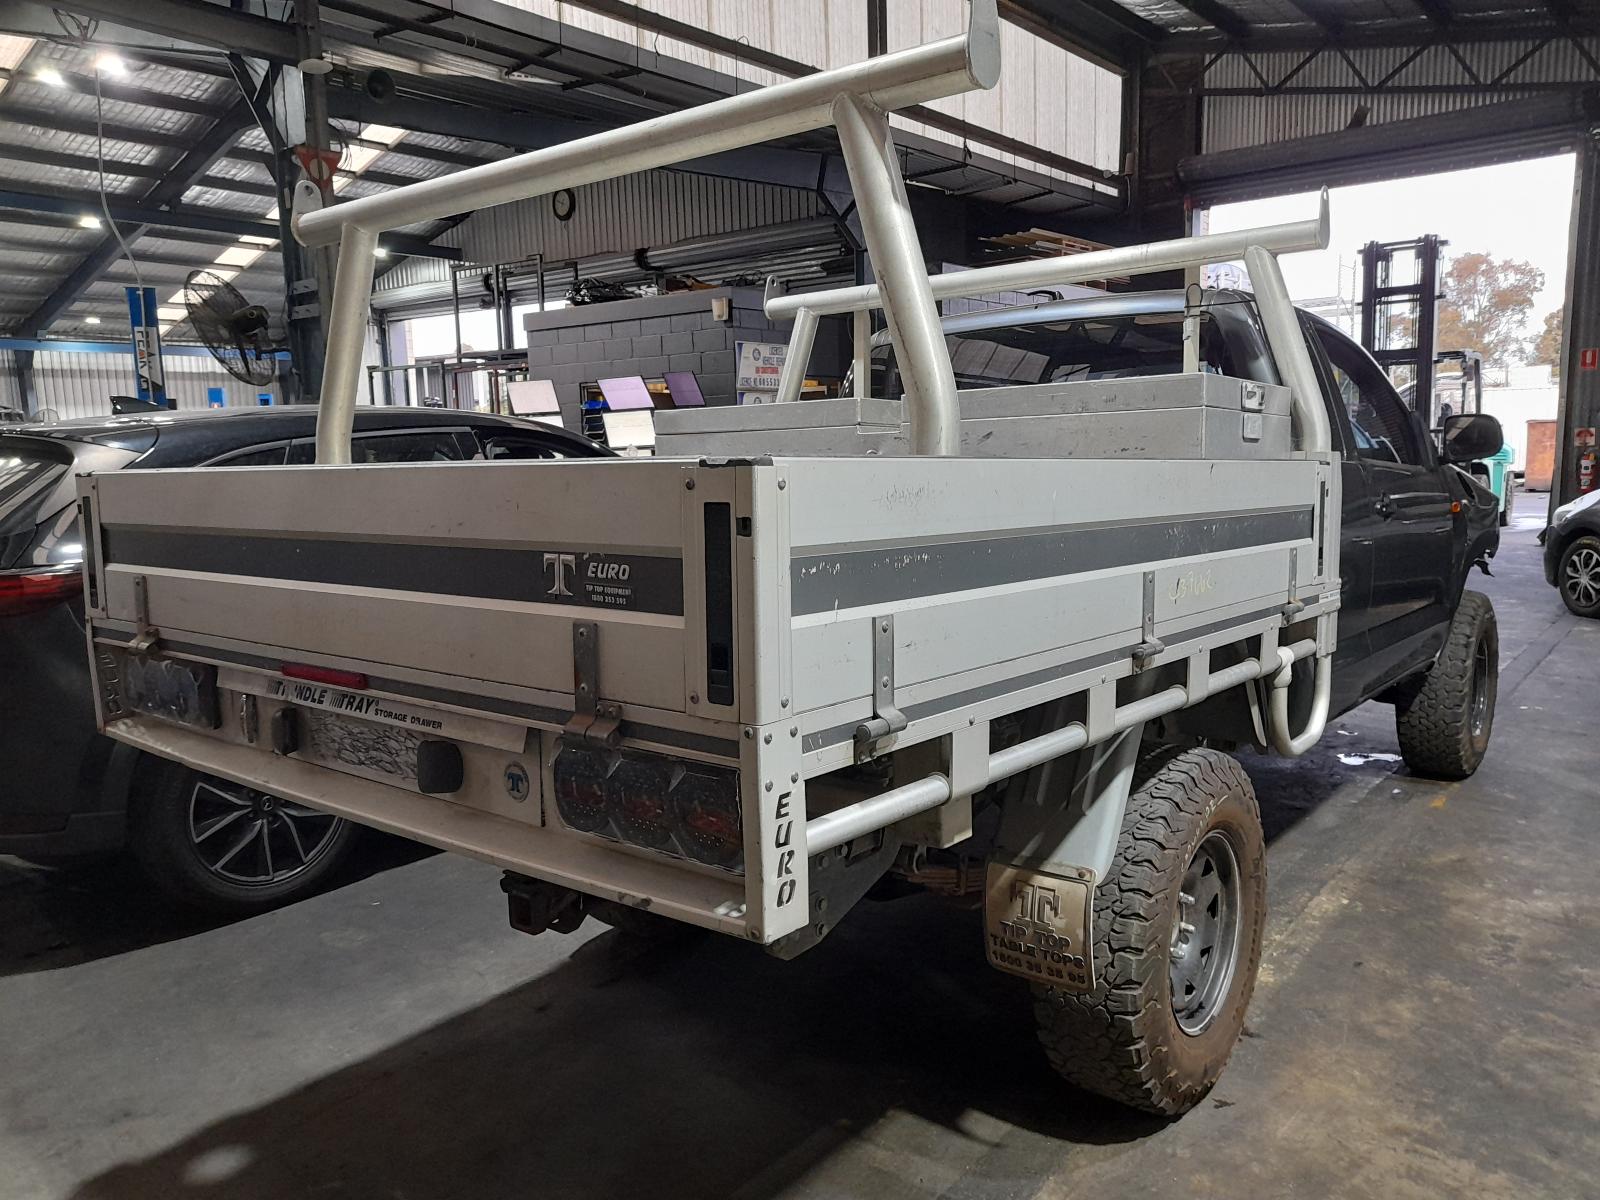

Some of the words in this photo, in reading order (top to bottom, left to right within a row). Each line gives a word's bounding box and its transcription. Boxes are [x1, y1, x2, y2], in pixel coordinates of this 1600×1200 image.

[587, 562, 630, 580] EURO
[604, 586, 632, 596] EQUIPMENT
[275, 680, 328, 705] TNDLE
[374, 707, 408, 723] STORAGE
[410, 715, 443, 730] DRAWER
[775, 791, 796, 908] EURO
[990, 932, 1037, 959] TABLE
[1040, 946, 1085, 970] TOPS
[999, 921, 1028, 941] TIP
[1034, 929, 1072, 953] TOP
